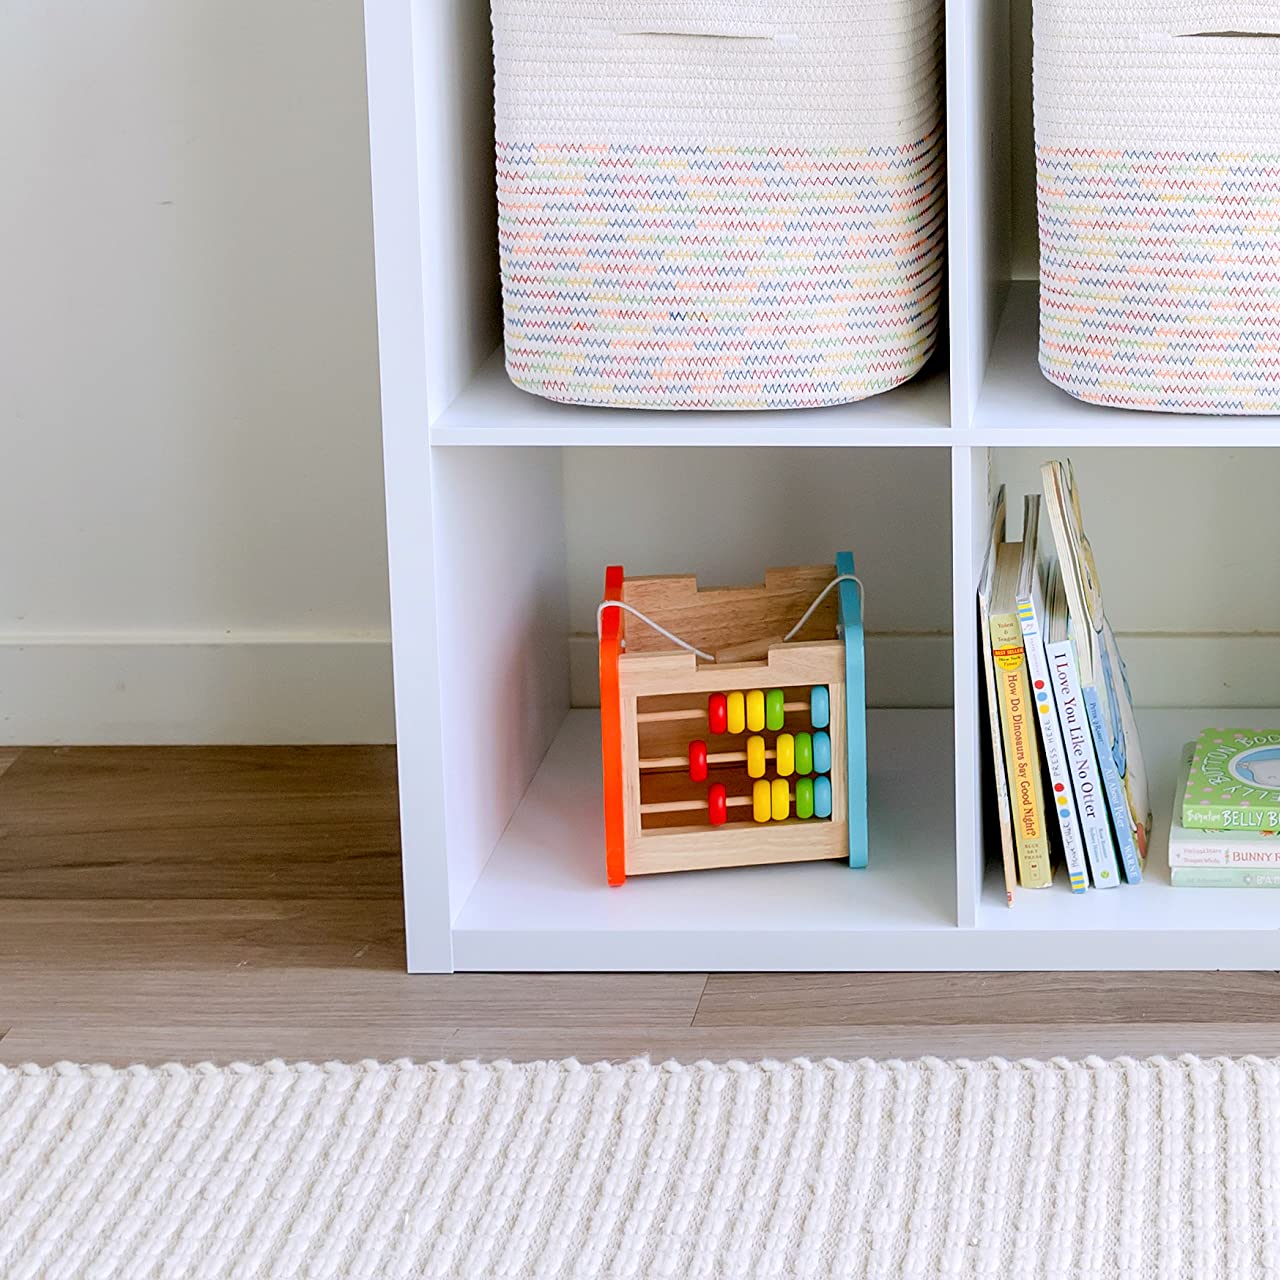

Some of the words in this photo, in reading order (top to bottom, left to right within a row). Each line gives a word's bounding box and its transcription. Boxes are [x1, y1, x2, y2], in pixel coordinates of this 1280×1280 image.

[1008, 674, 1018, 696] How
[1056, 663, 1070, 695] Love
[1010, 699, 1021, 712] Do
[1064, 697, 1077, 723] You
[1012, 715, 1025, 760] Dinosaurs
[1044, 720, 1055, 743] HERE
[1069, 727, 1084, 756] Like
[1017, 763, 1028, 779] Say
[1049, 748, 1060, 777] PRESS
[1075, 759, 1090, 779] No
[1201, 745, 1238, 786] BUTTON
[1020, 781, 1032, 806] Good
[1081, 782, 1096, 818] Otter
[1108, 782, 1119, 804] About
[1114, 806, 1124, 828] Peter
[1023, 808, 1036, 836] Night?
[1222, 809, 1264, 827] BELLY
[1124, 845, 1137, 878] WARNE
[1232, 851, 1273, 862] BUNNY
